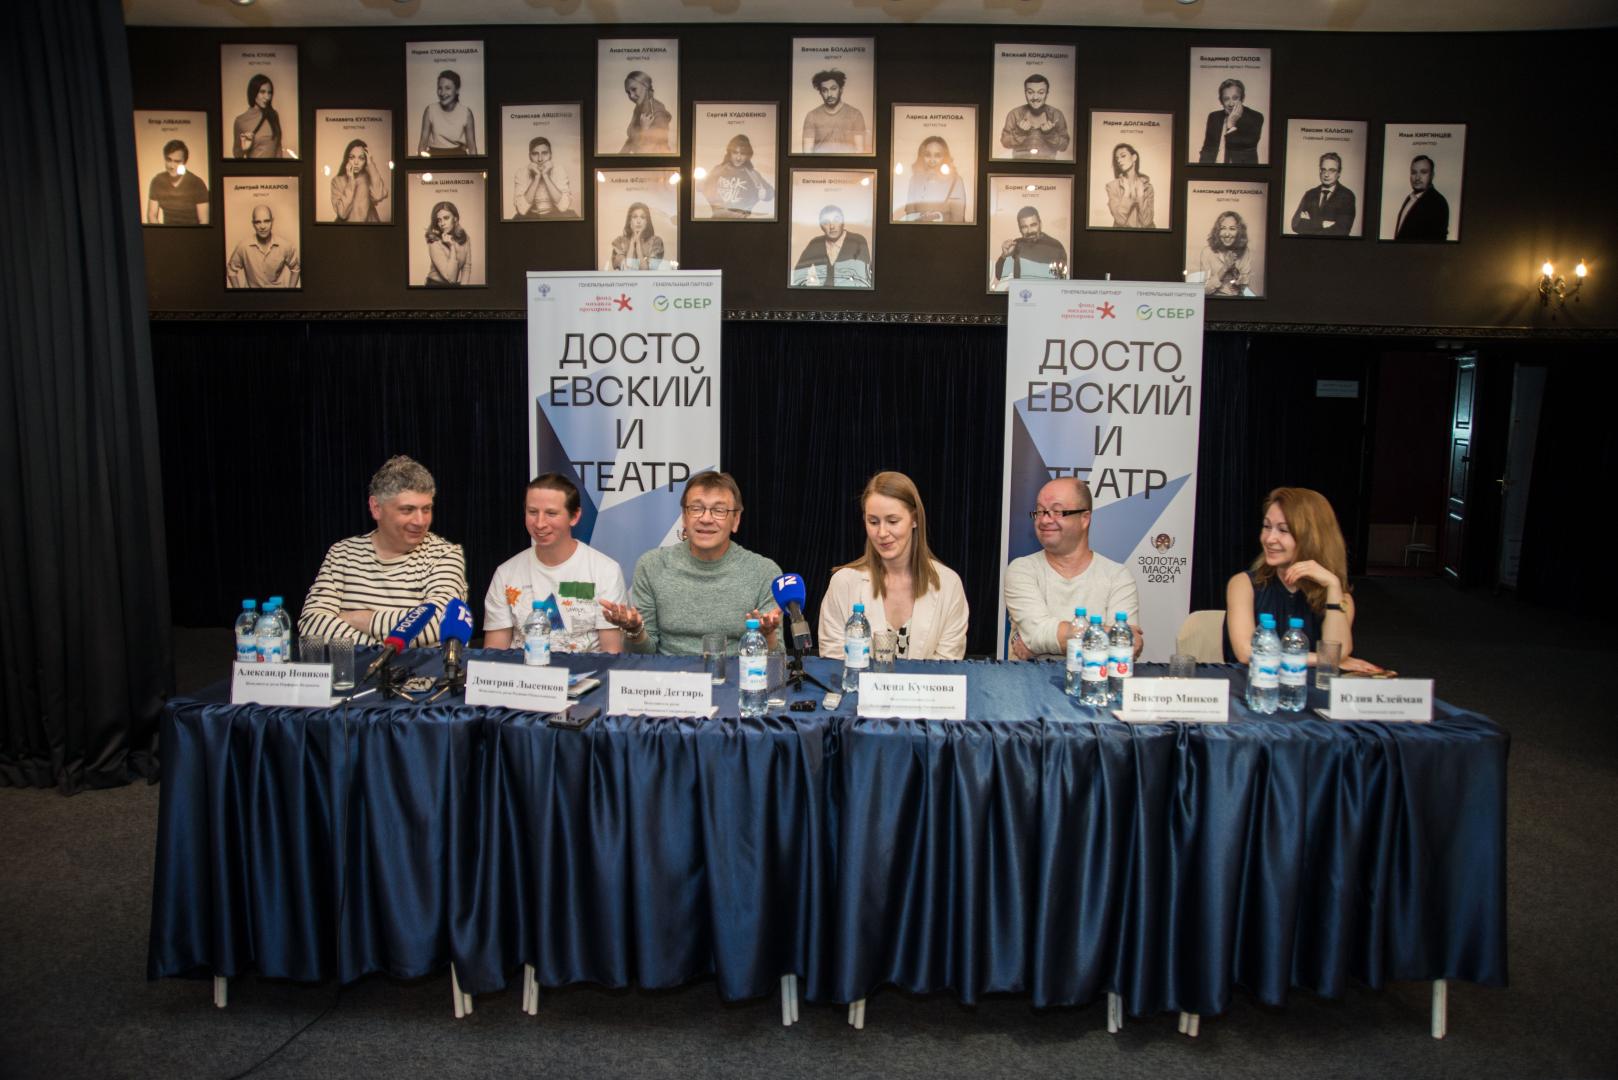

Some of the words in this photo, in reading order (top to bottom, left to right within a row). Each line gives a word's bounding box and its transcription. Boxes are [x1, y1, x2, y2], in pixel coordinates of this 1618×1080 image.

[673, 298, 712, 309] СБЕР
[1156, 307, 1195, 319] СБЕР
[559, 332, 700, 369] ДОСТО
[1038, 339, 1182, 375] ДОСТО
[550, 366, 711, 407] ЕВСКИЙ
[1027, 375, 1192, 416] ЕВСКИЙ
[616, 419, 643, 449] И
[1094, 425, 1122, 456] И
[571, 461, 690, 493] ТЕАТР
[1138, 556, 1187, 566] ЗОЛОТАЯ
[1142, 566, 1181, 574] МАСКА
[777, 575, 797, 591] 12
[1148, 575, 1175, 583] 2021
[395, 606, 429, 633] РОССИЯ
[237, 668, 287, 679] Александр
[289, 669, 330, 678] Новиков
[472, 676, 514, 688] Дмитрий
[516, 680, 564, 692] Лысенков
[872, 682, 904, 692] Алена
[908, 682, 955, 694] Кучкова
[620, 686, 661, 698] Валерий
[664, 688, 704, 699] Дегтярь
[1132, 693, 1173, 704] Виктор
[1176, 693, 1219, 704] Минков
[1340, 693, 1373, 704] Юлия
[1375, 693, 1423, 704] Клейман
